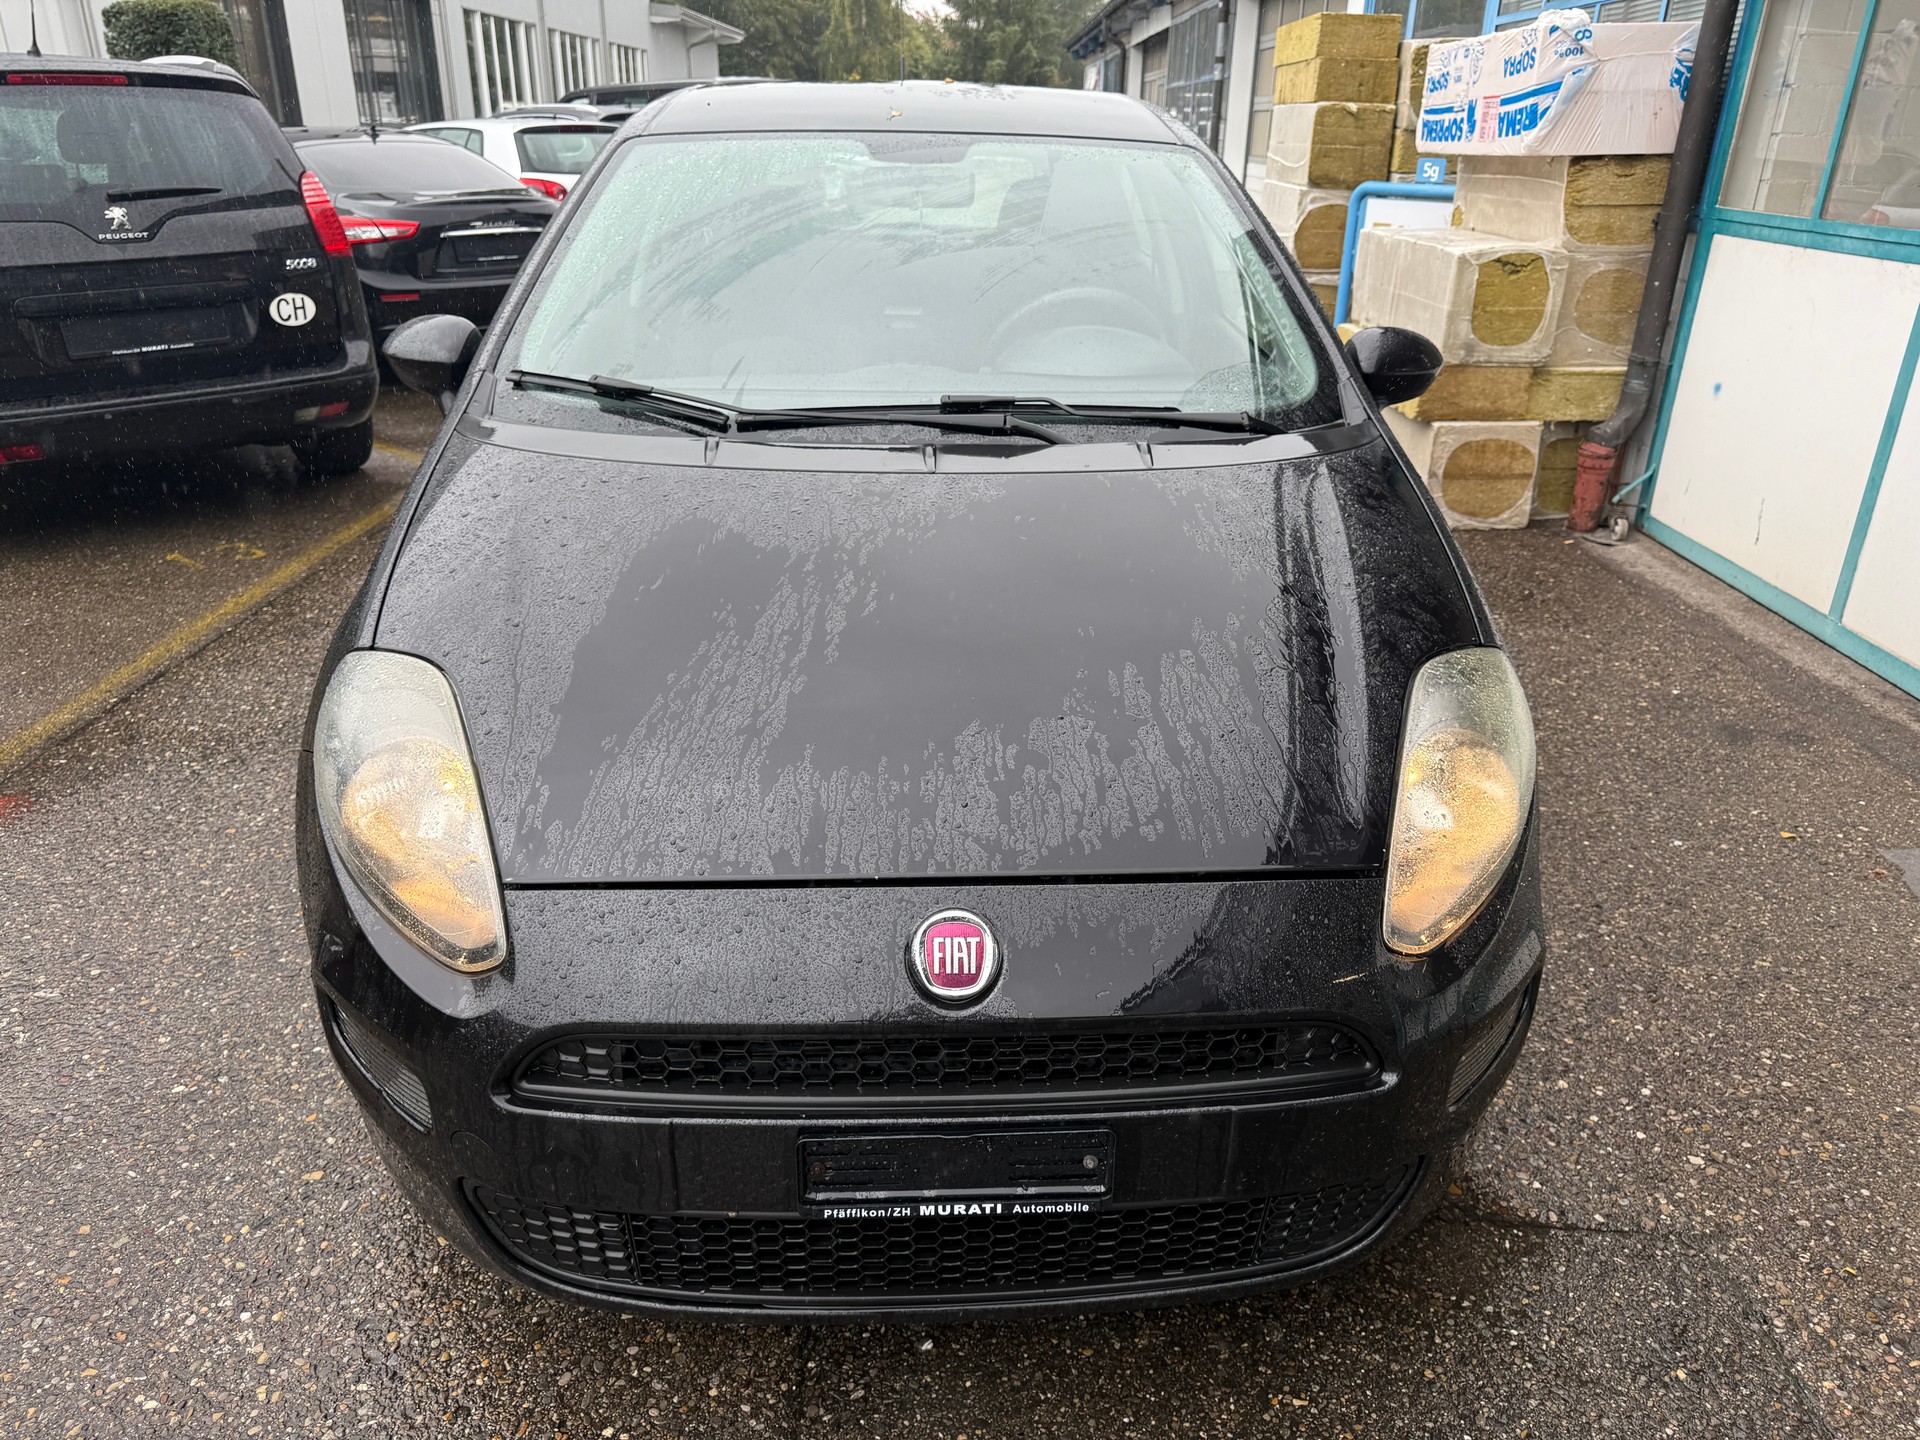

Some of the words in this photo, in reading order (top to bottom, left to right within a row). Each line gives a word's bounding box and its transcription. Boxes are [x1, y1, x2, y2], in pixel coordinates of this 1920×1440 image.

[1503, 46, 1537, 78] SOPRA
[1554, 46, 1585, 59] 100%
[1421, 117, 1465, 143] SOPREMA
[1497, 102, 1540, 139] REMA
[1422, 161, 1440, 182] 5g
[98, 231, 149, 240] PEUGEOT
[285, 257, 317, 270] 5008
[276, 297, 307, 321] CH
[932, 936, 981, 975] FIAT
[823, 1207, 911, 1219] Pfäffikon/ZH
[919, 1203, 1002, 1216] MURATI
[1012, 1202, 1090, 1214] Automobile
